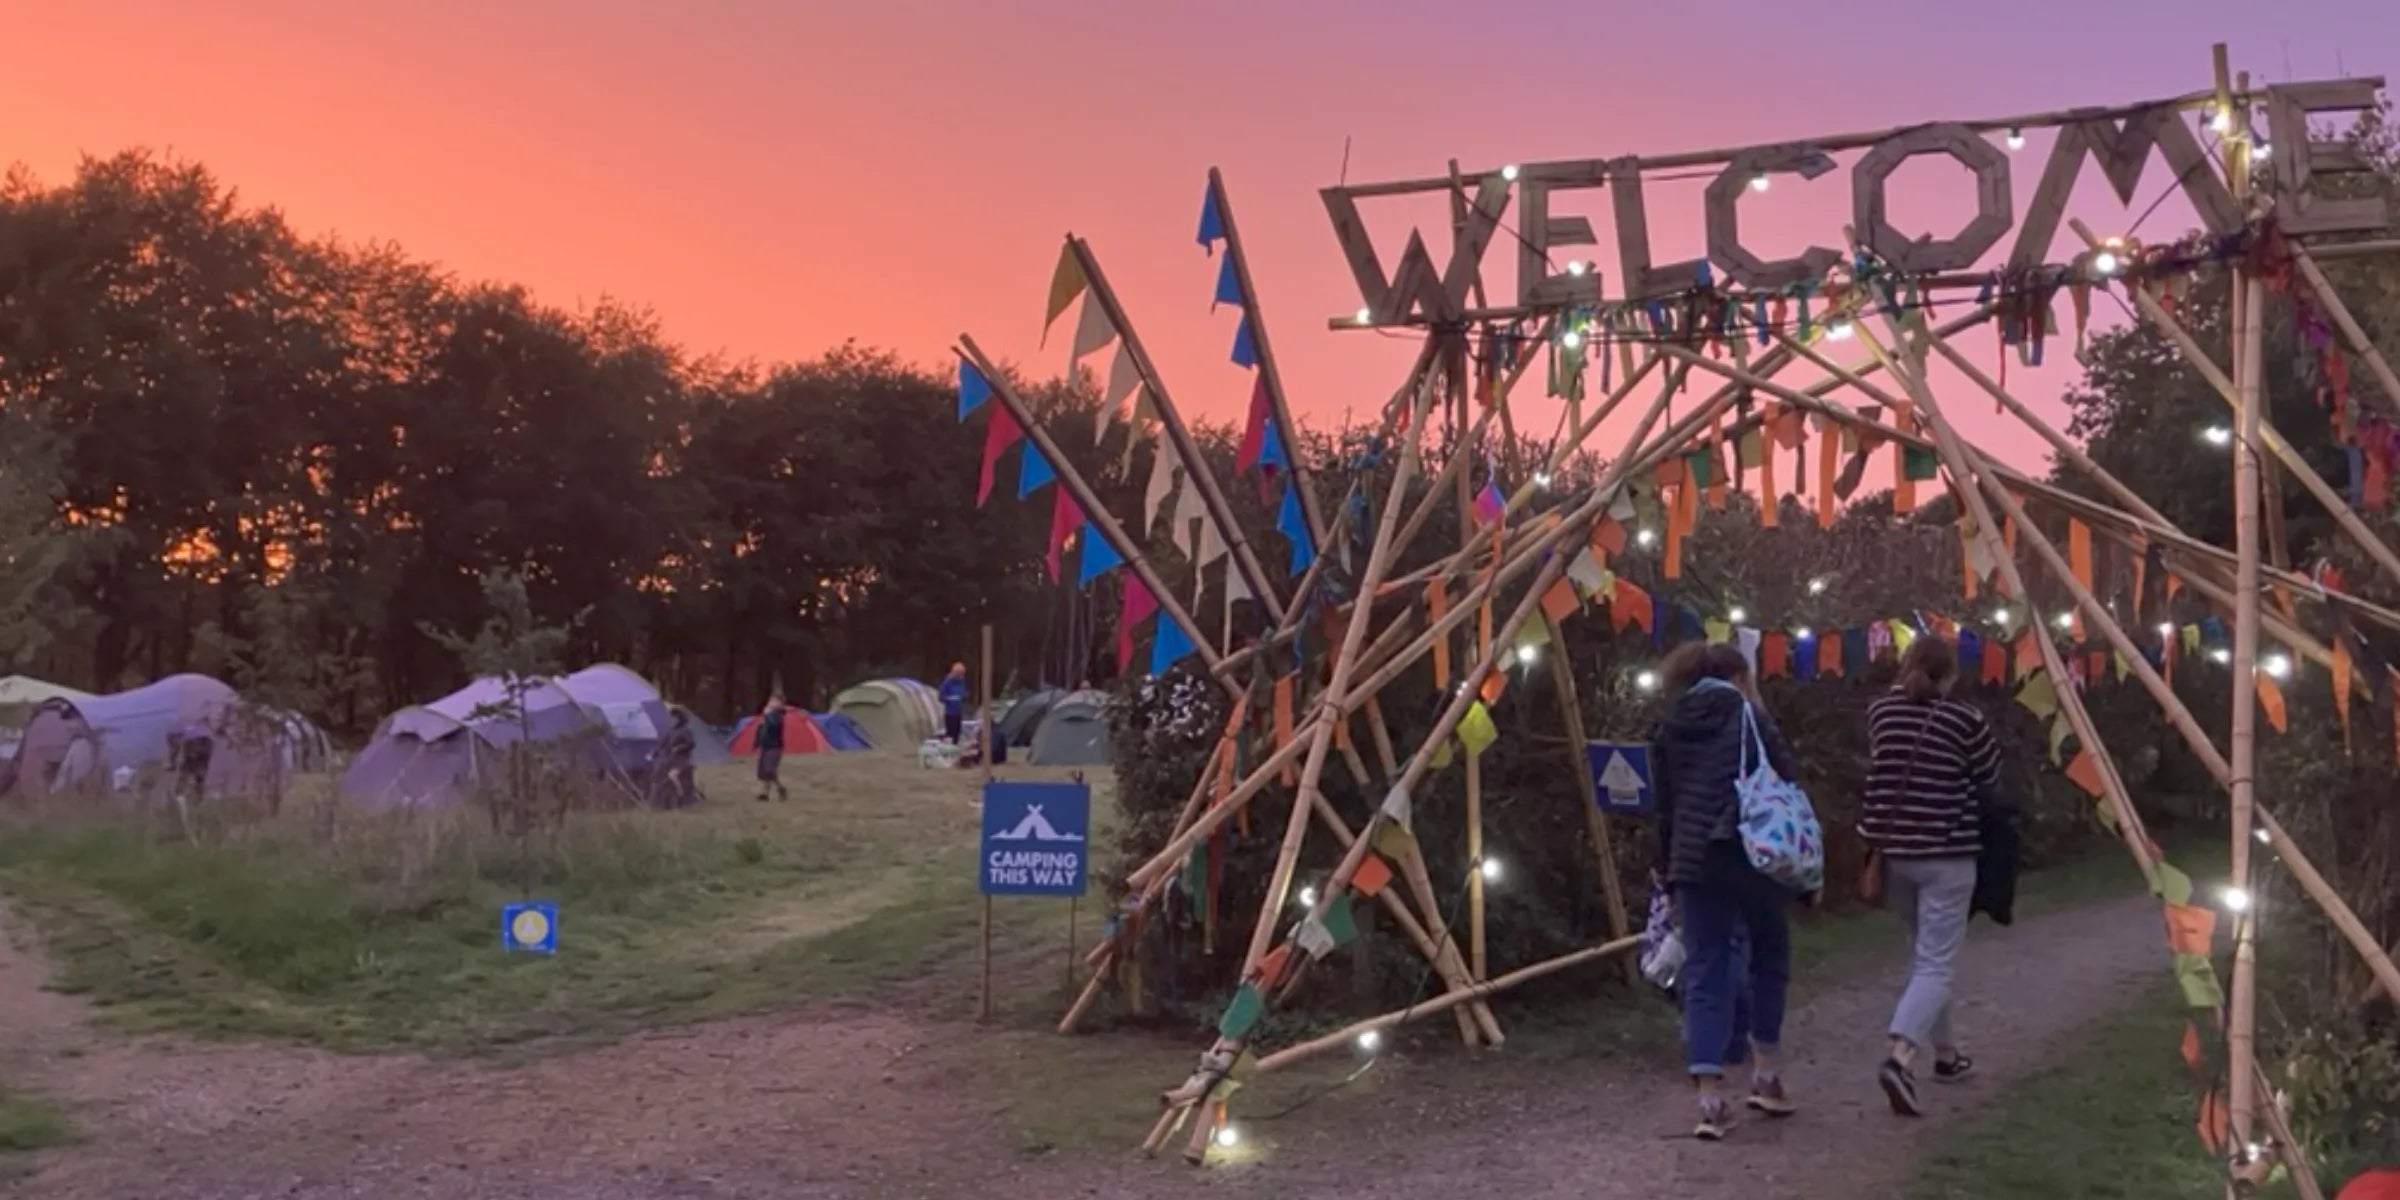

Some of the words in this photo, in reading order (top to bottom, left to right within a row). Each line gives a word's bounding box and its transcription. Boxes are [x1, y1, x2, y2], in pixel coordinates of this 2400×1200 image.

[1320, 78, 2390, 325] WELCOME
[989, 850, 1078, 869] CAMPING
[989, 868, 1028, 884] THIS
[1031, 869, 1077, 886] WAY
